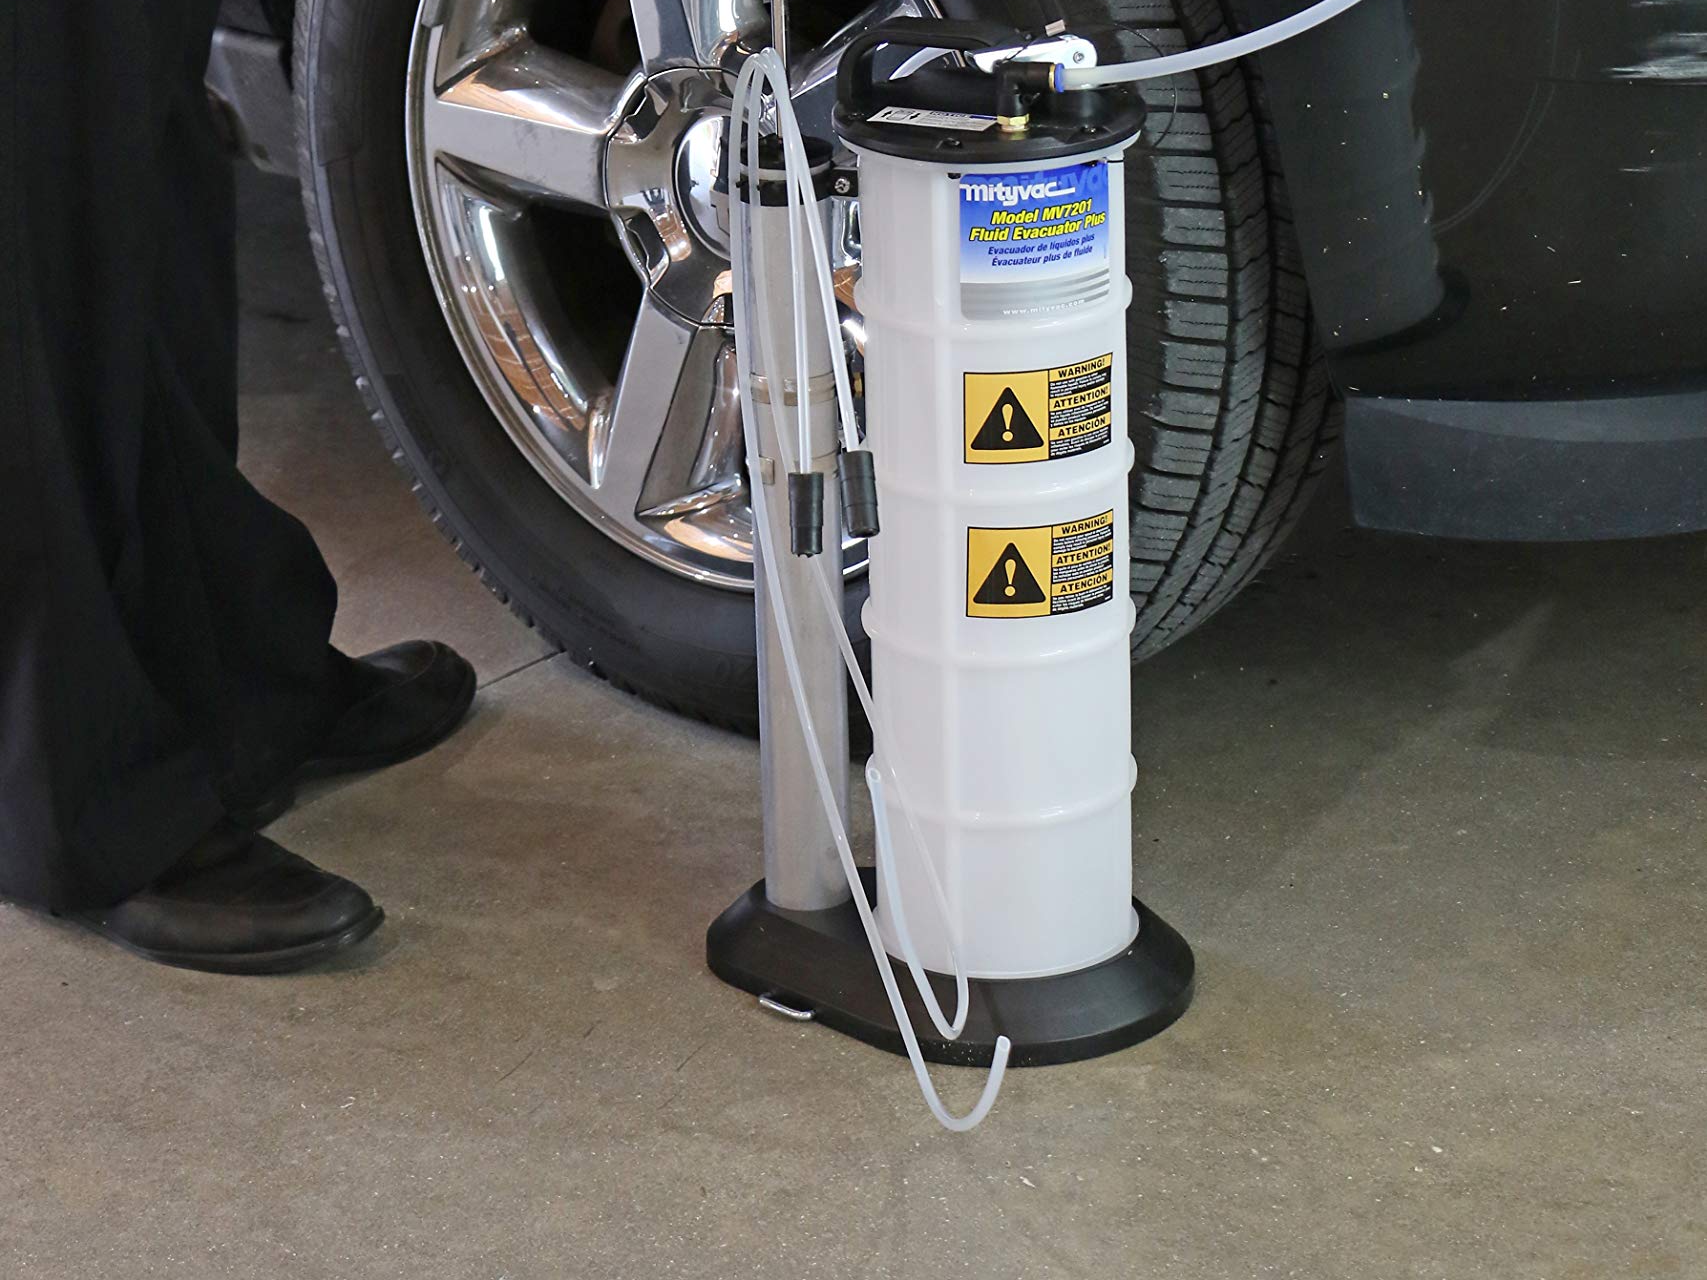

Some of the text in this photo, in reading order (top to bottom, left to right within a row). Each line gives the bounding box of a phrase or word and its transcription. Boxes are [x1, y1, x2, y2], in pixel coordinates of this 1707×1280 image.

[959, 182, 1075, 206] mityvac
[990, 198, 1093, 225] Model MV7201
[969, 213, 1106, 241] Fluid Evacuator Plus
[988, 246, 1035, 255] Evacuador
[1037, 243, 1048, 251] de
[1081, 233, 1095, 245] plus
[991, 257, 1040, 266] Évacuateur
[1043, 253, 1061, 264] plus
[1074, 245, 1093, 256] fluide
[1058, 358, 1105, 379] WARNING!
[1054, 386, 1108, 409] ATTENTION!
[1058, 416, 1106, 438] ATENCIÓN
[1061, 515, 1108, 535] WARNING!
[1056, 544, 1111, 565] ATTENTION!
[1060, 573, 1108, 593] ATENCIÓN
